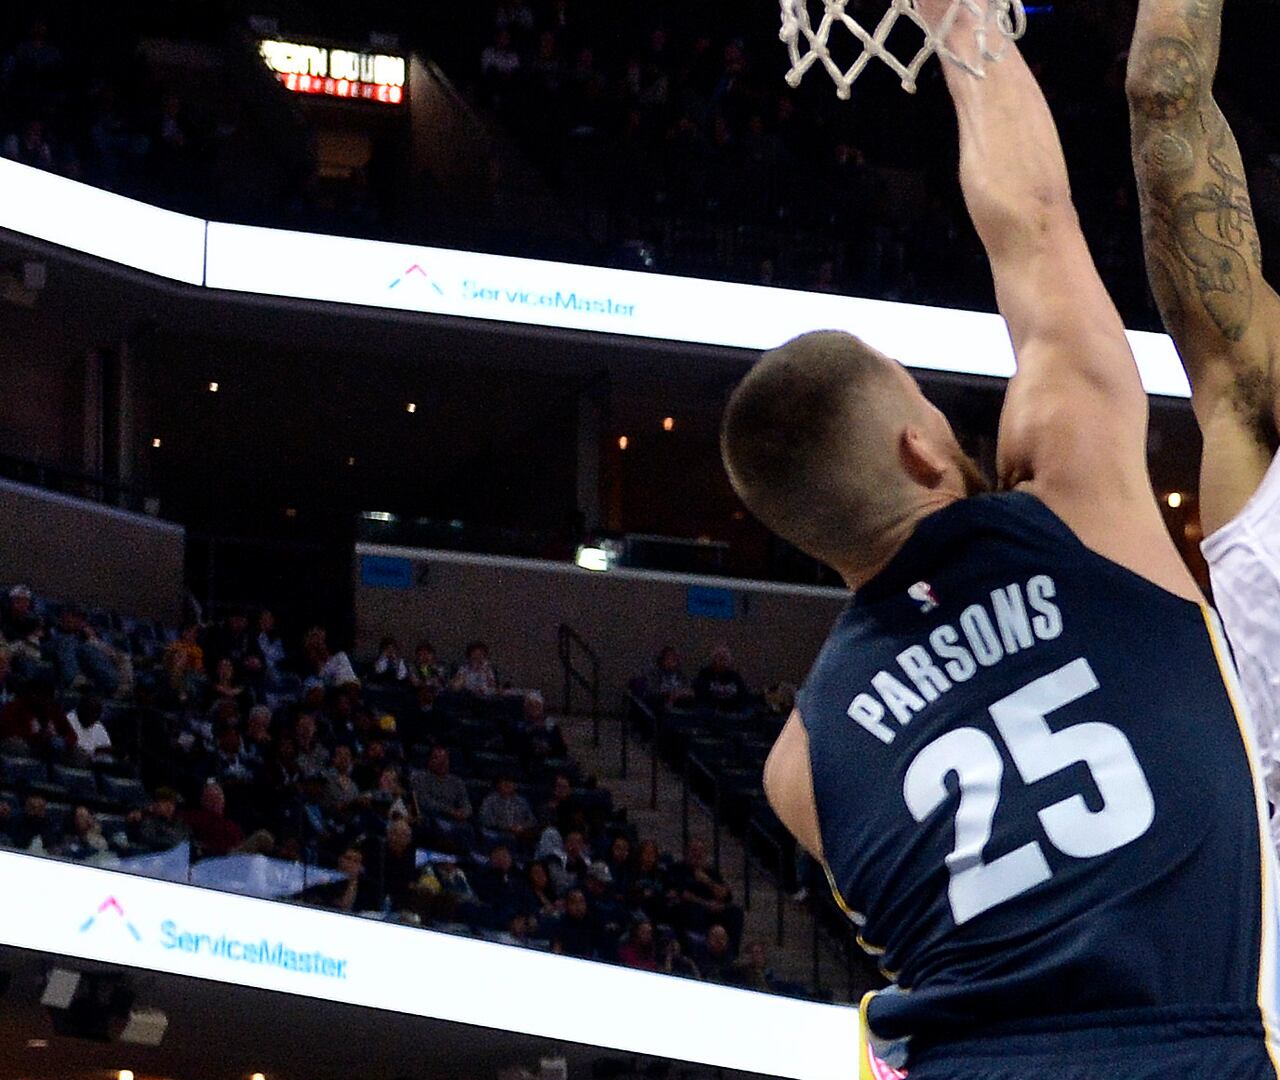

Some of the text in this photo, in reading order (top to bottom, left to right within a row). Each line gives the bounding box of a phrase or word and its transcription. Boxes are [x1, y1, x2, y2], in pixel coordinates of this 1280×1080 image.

[462, 278, 636, 317] ServiceMaster
[847, 574, 1064, 745] PARSONS
[903, 656, 1156, 926] 25
[160, 919, 346, 980] ServiceMaster
